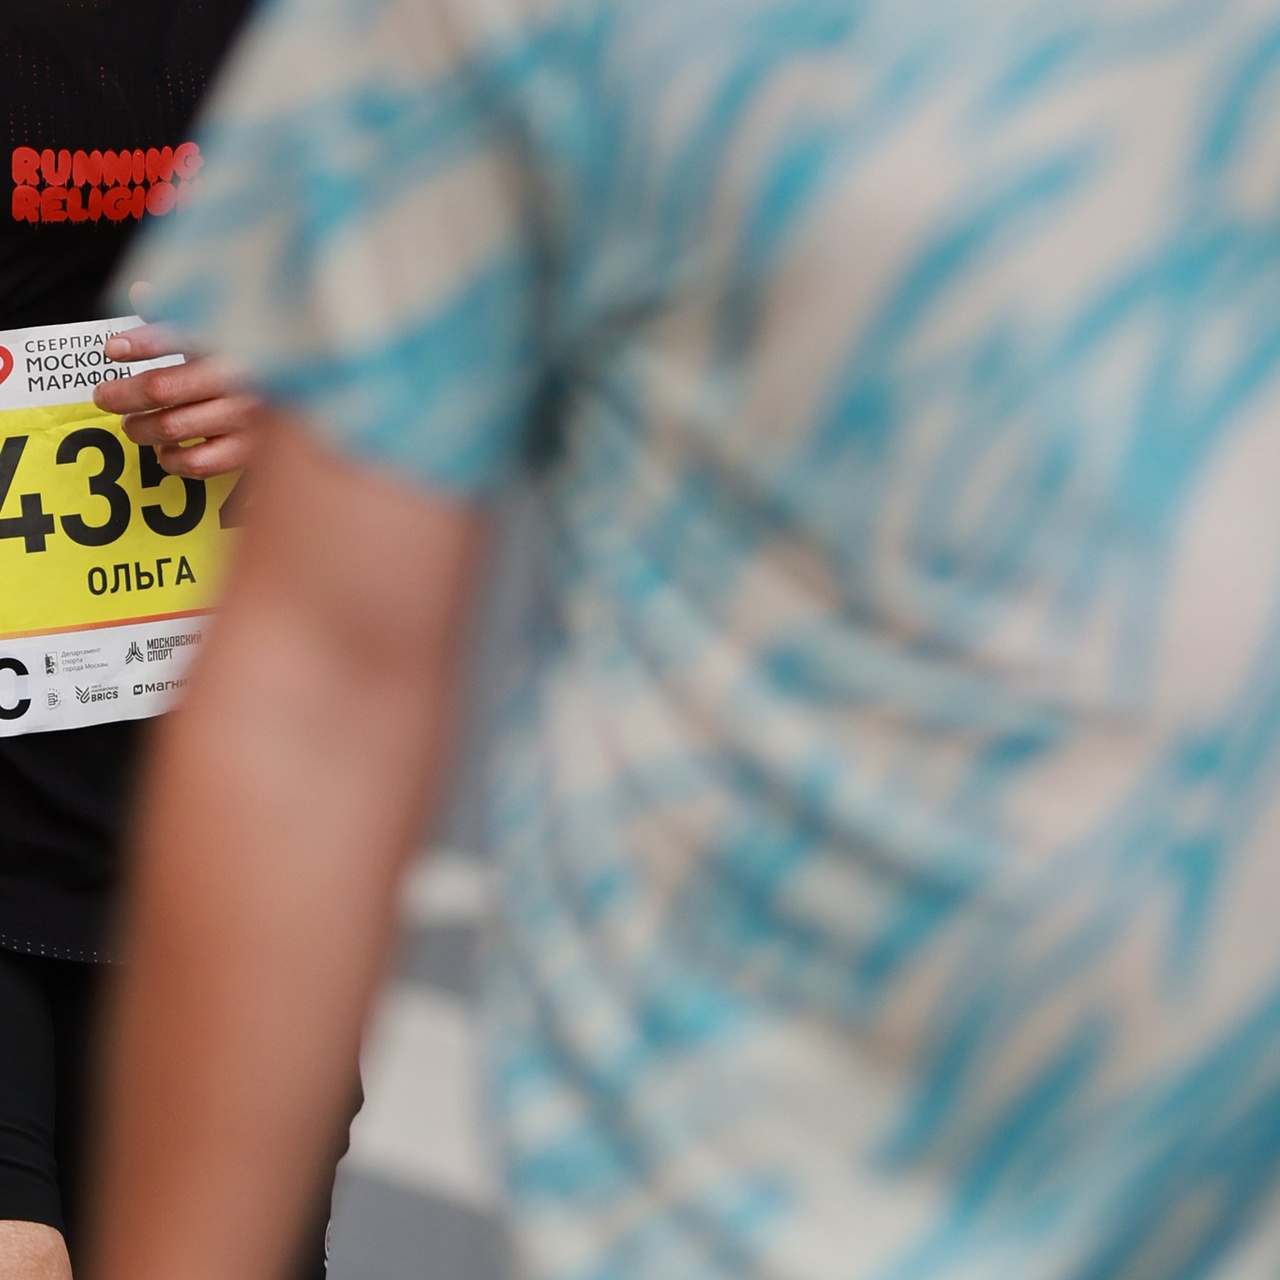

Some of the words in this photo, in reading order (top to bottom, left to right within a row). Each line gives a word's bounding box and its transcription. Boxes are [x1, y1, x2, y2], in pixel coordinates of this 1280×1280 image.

[12, 142, 204, 187] RUNNING
[28, 366, 132, 392] МАРАФОН
[87, 555, 197, 596] ОЛЬГА
[147, 648, 173, 662] СПОРТ
[91, 690, 119, 702] BRICS
